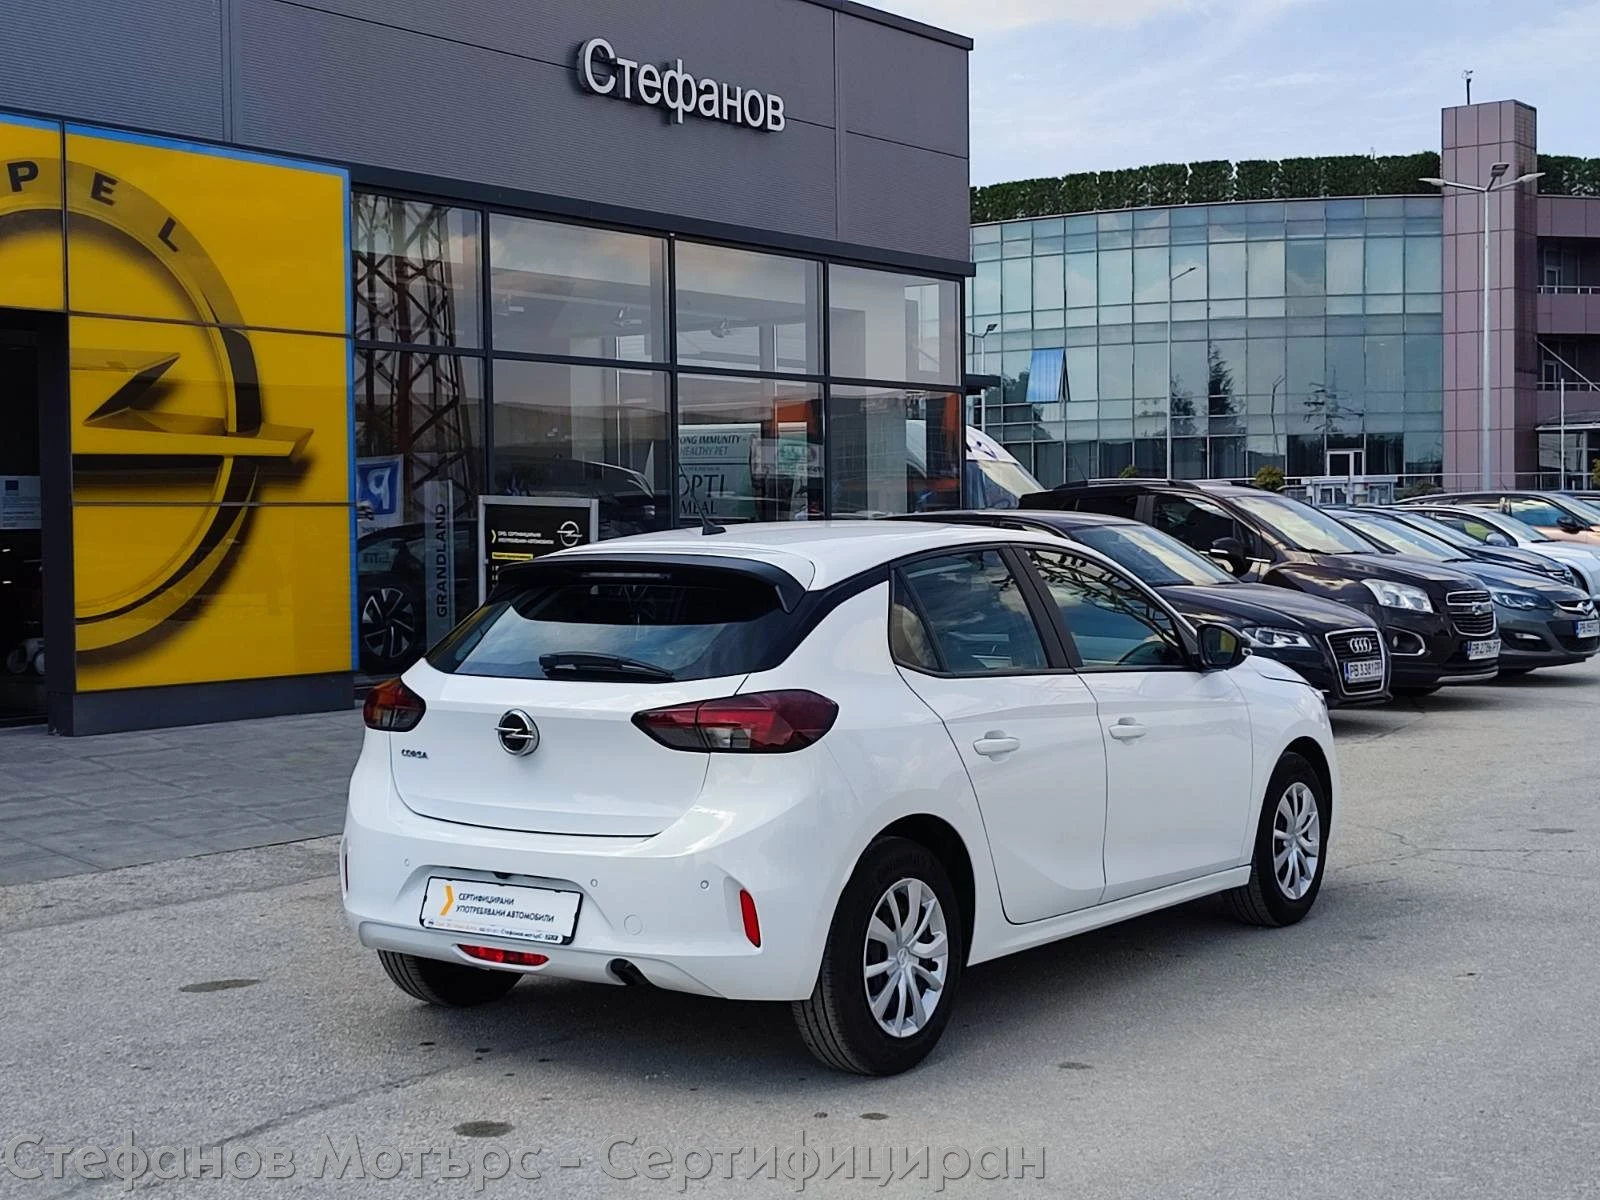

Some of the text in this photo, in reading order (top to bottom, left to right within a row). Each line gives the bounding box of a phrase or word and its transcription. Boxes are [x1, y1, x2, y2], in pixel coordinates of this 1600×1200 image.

[579, 38, 786, 132] Стефанов
[699, 434, 741, 444] IMMUNITY
[437, 503, 447, 617] GRANDLAND
[401, 748, 429, 760] CORSA
[458, 892, 515, 905] СЕРТИФИЦИРАНИ
[506, 910, 555, 923] АВТОМОБИЛИ
